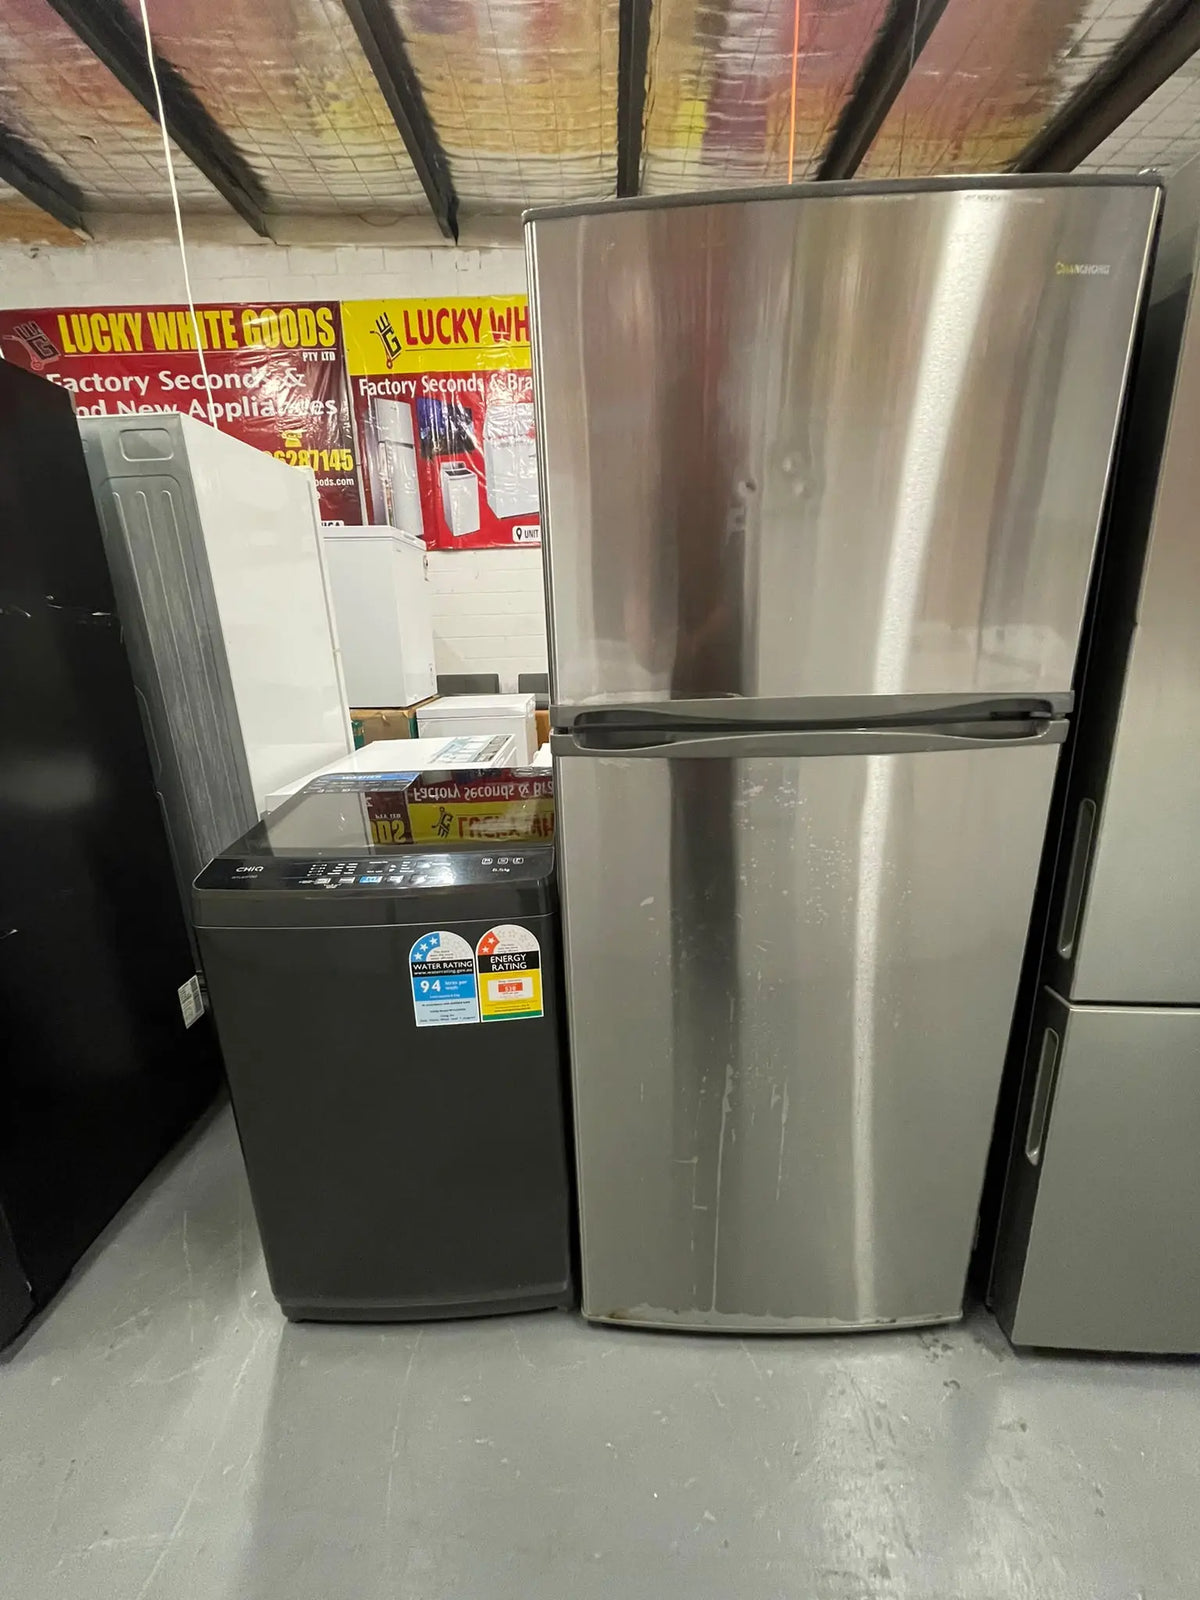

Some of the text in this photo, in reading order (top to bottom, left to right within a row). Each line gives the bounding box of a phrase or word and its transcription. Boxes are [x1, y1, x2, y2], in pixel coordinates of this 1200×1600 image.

[57, 307, 336, 353] LUCKY WHITE GOODS
[404, 307, 482, 345] LUCKY
[303, 351, 336, 362] PTY LTD
[277, 367, 307, 389] &
[359, 377, 416, 398] Factory
[422, 373, 485, 394] Seconds
[489, 373, 501, 392] &
[117, 399, 178, 415] New
[188, 394, 338, 422] Appliaes
[263, 449, 354, 472] 6287145
[524, 529, 539, 539] UNIT
[413, 961, 473, 970] WATER RATING
[490, 953, 527, 963] ENERGY
[491, 962, 527, 971] RATING
[420, 980, 441, 993] 94
